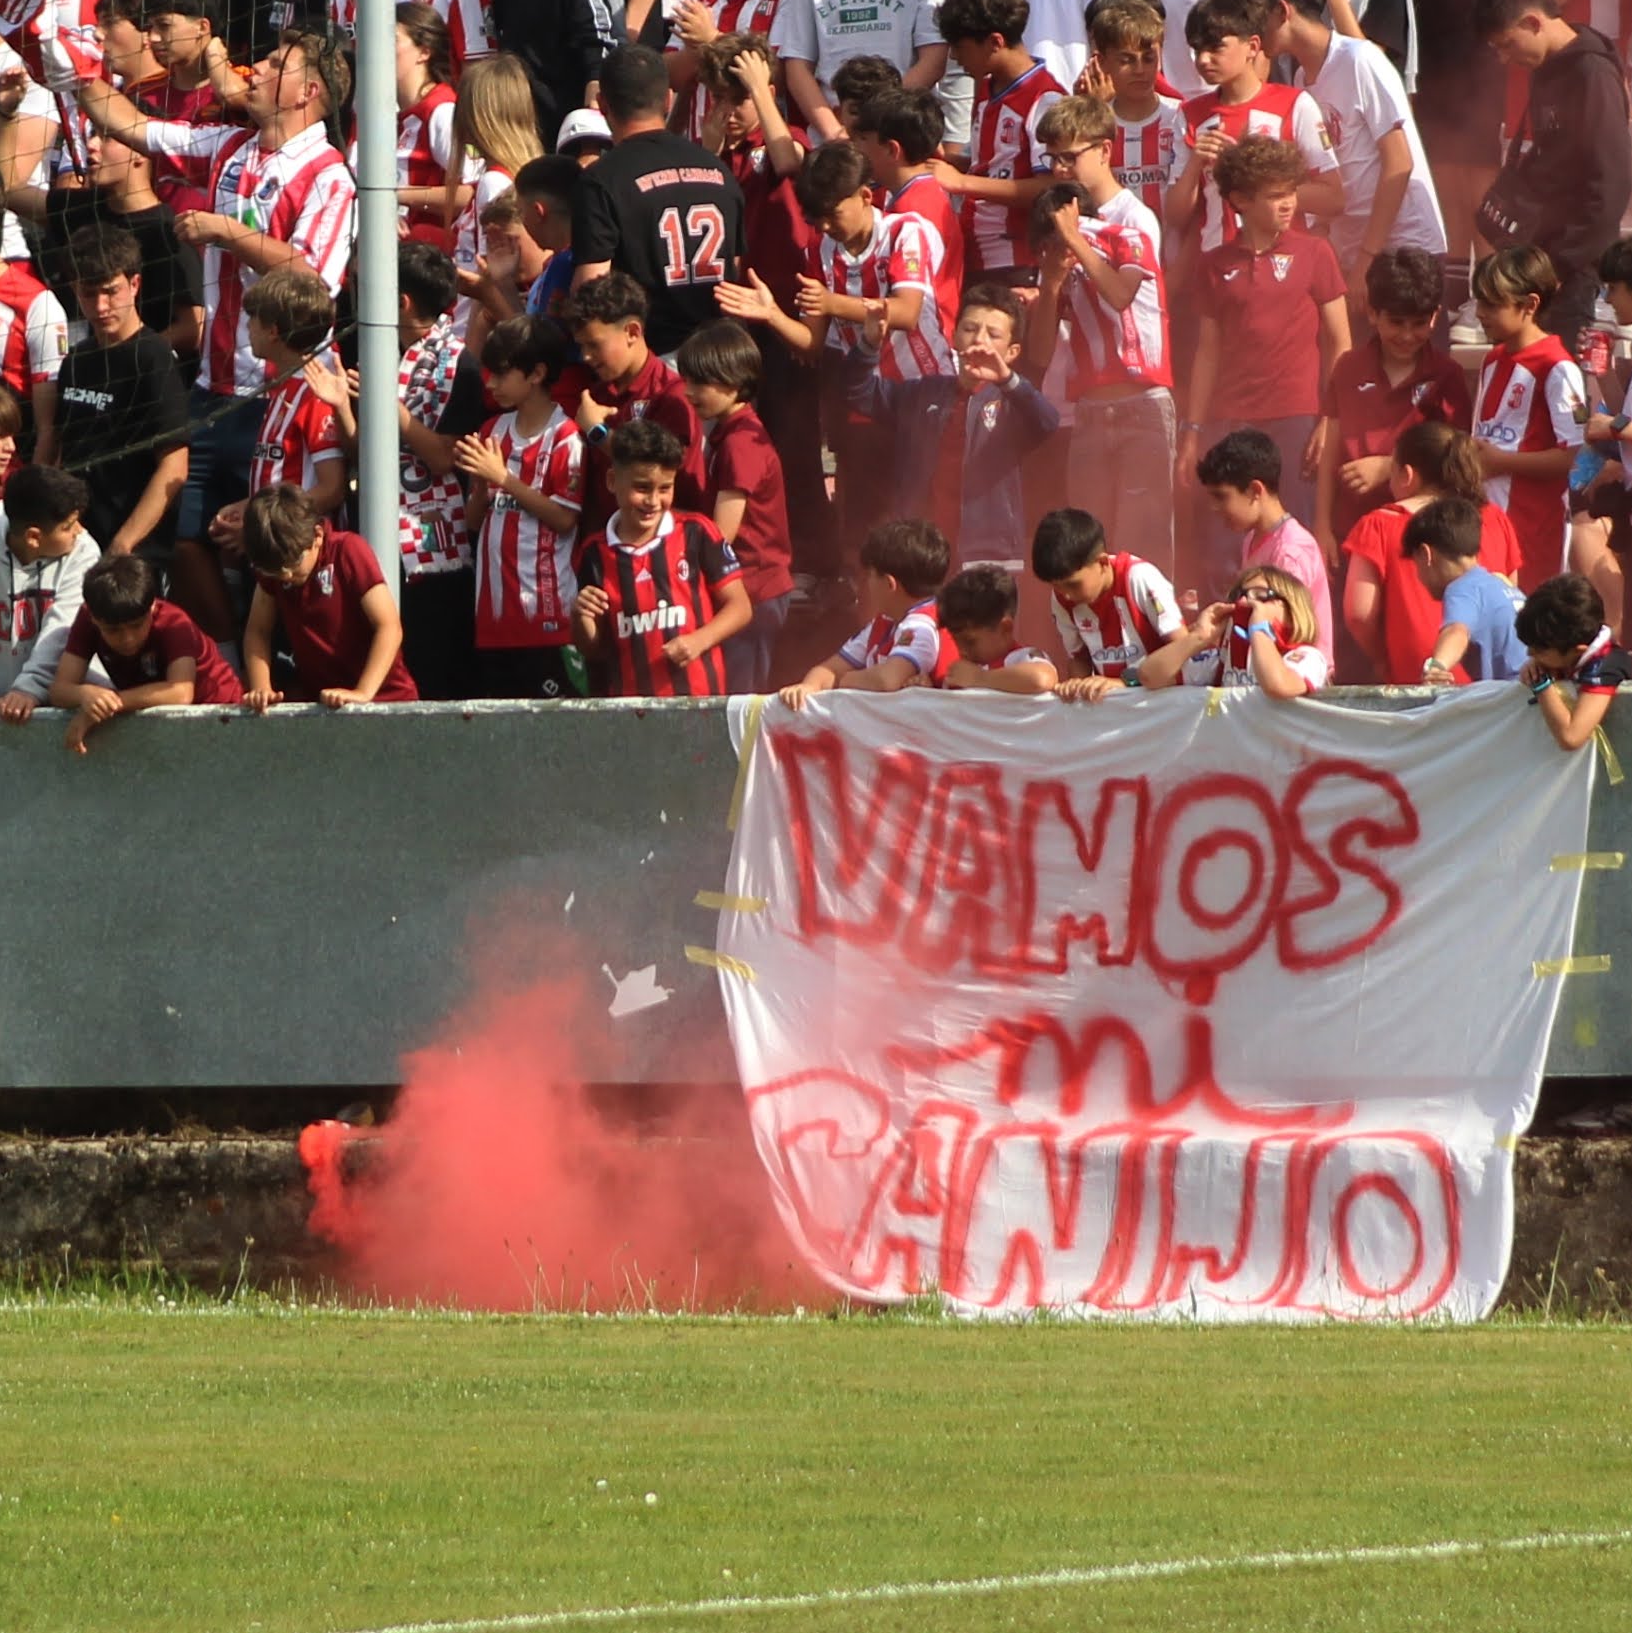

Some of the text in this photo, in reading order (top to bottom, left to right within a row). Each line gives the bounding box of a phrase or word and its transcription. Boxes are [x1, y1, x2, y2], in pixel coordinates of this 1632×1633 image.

[658, 203, 726, 286] 12
[616, 599, 687, 638] bwin
[769, 724, 1421, 976] VAMOS
